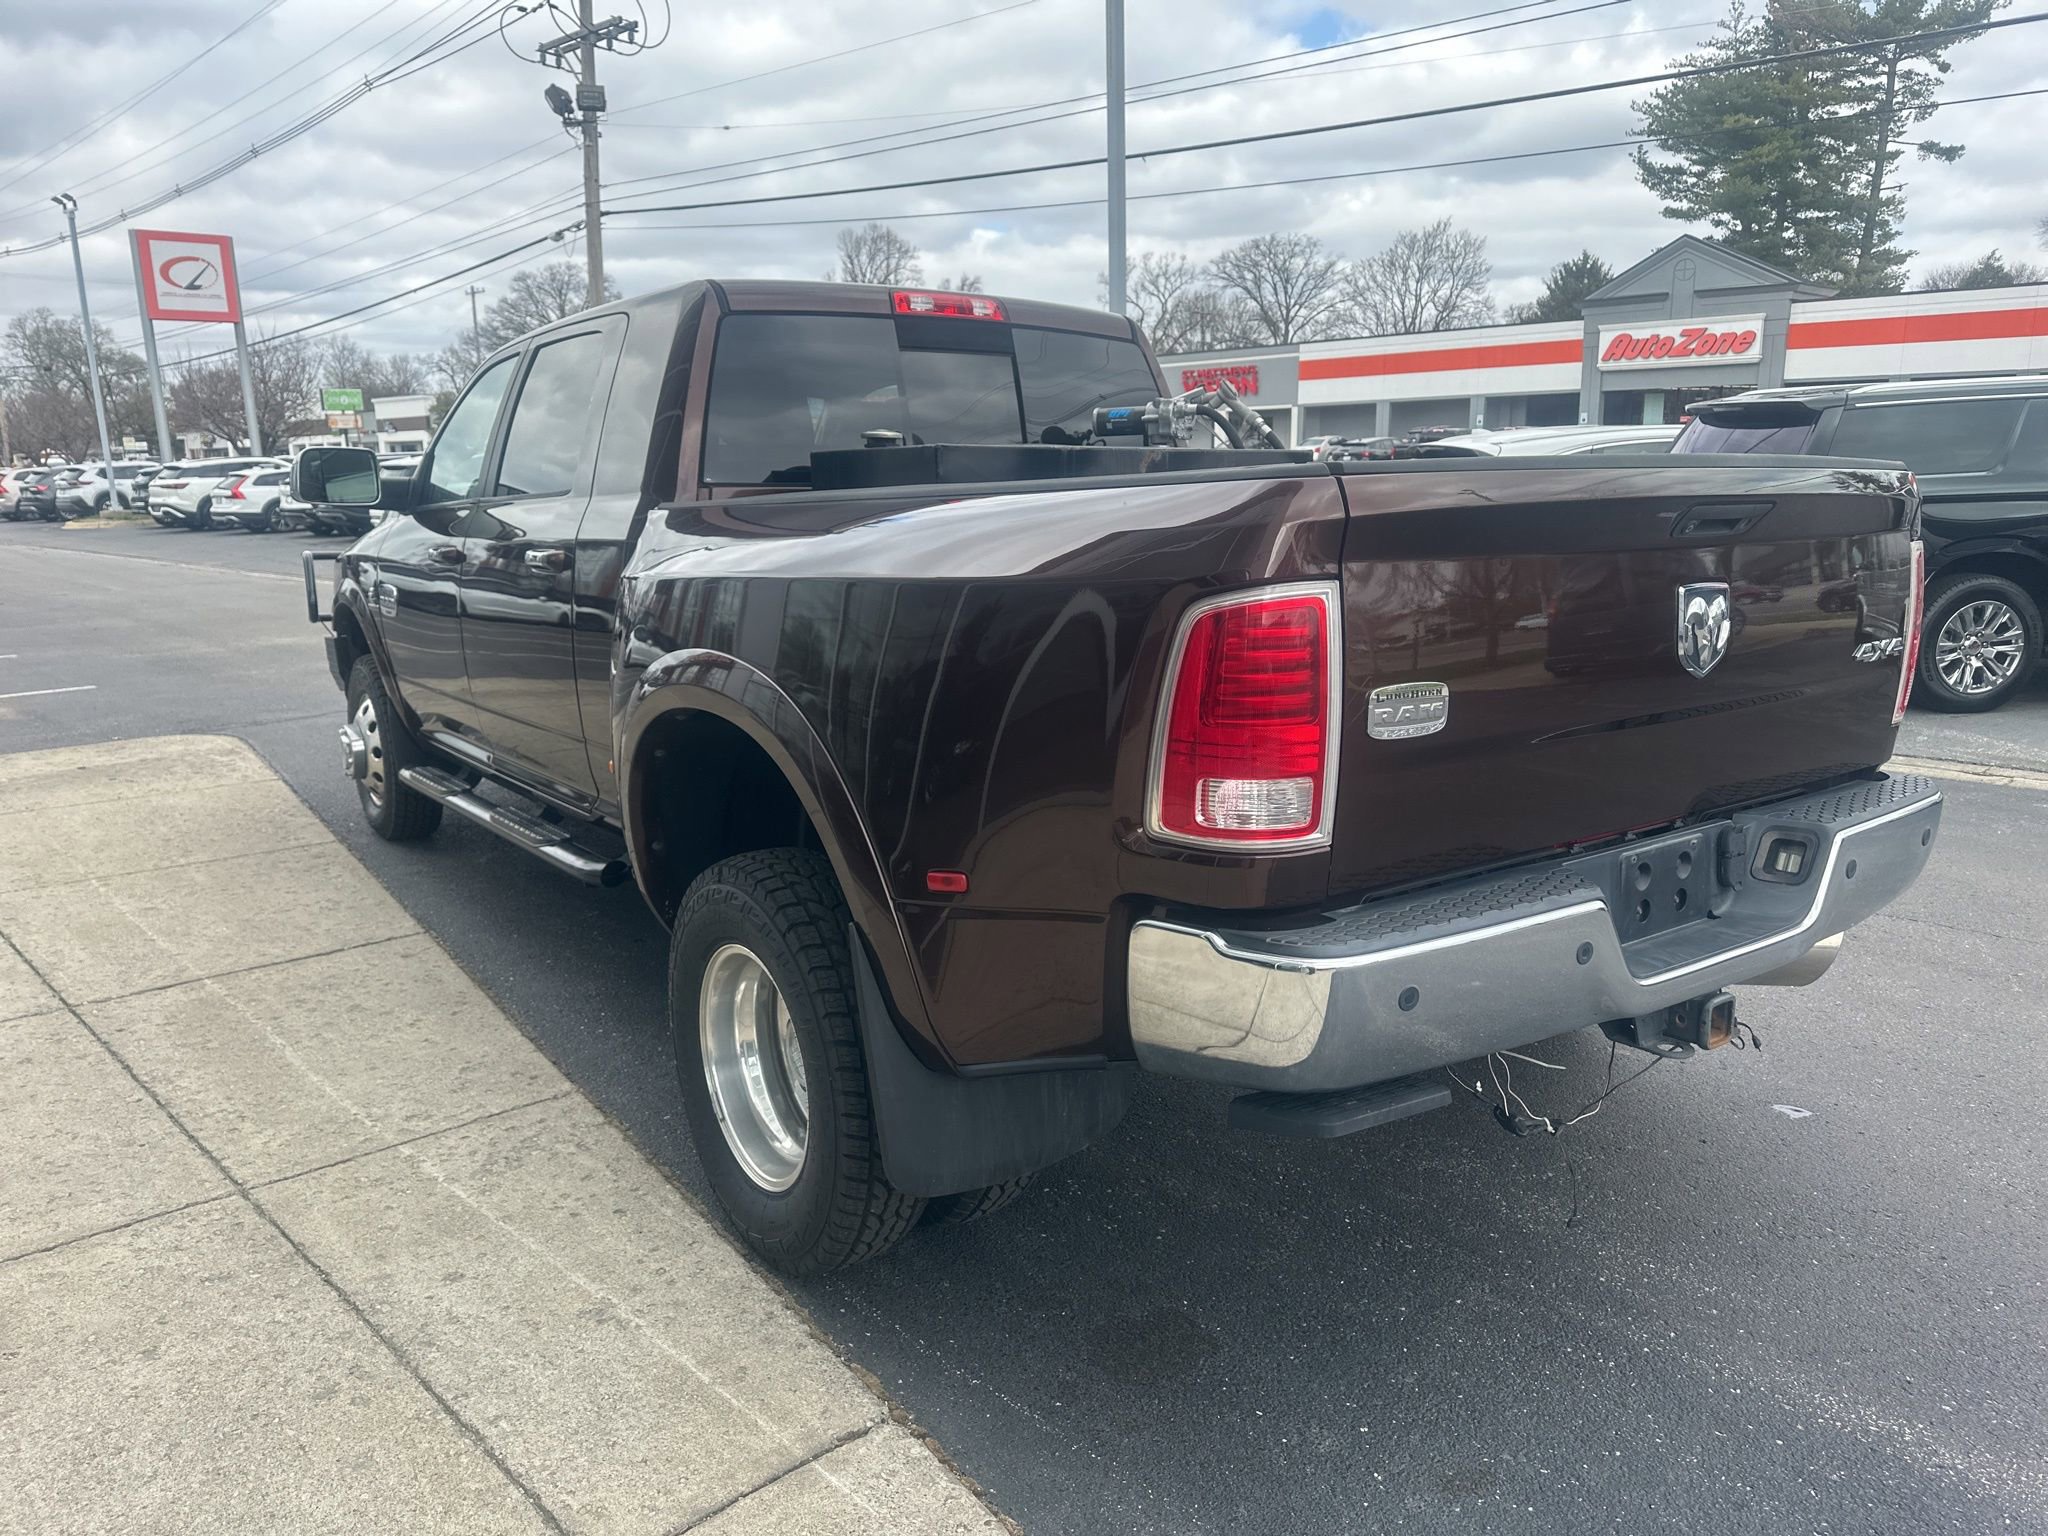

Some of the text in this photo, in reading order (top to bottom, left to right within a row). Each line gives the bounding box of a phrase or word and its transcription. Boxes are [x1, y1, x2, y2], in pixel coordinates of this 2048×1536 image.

[1601, 328, 1757, 361] AutoZone
[1183, 376, 1259, 396] VSIN
[1374, 702, 1445, 727] RAM
